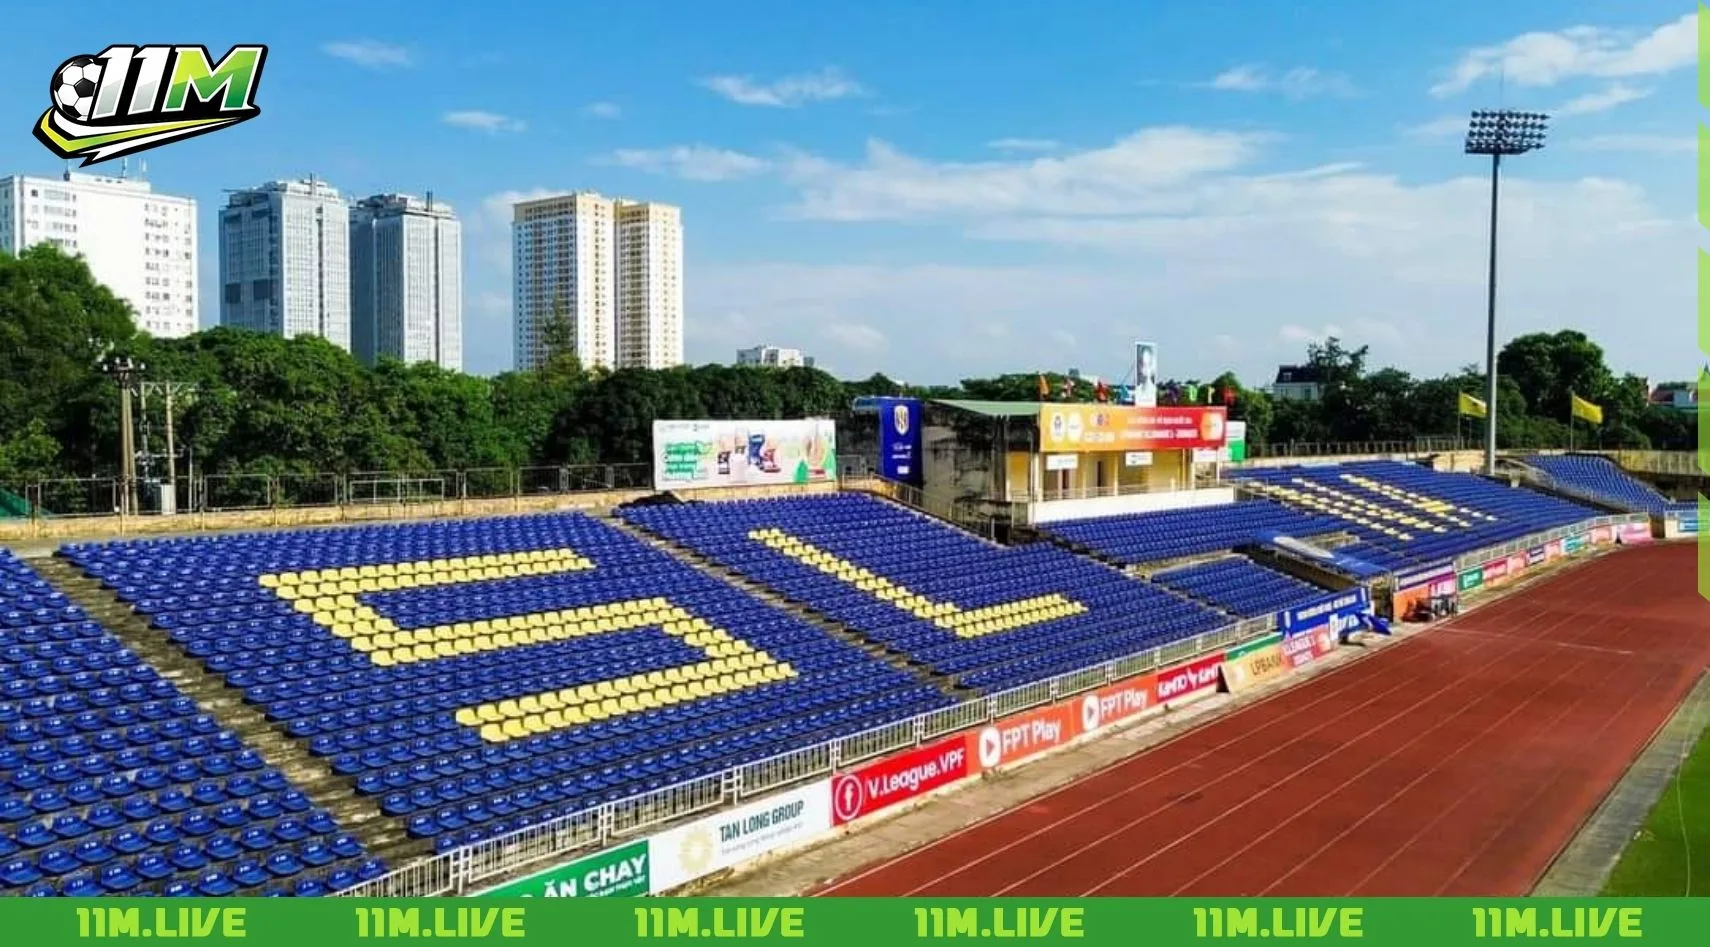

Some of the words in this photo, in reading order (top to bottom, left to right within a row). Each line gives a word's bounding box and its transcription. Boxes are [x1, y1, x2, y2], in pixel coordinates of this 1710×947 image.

[1101, 694, 1123, 719] FPT
[1124, 689, 1149, 712] Play
[1001, 724, 1031, 755] FPT
[1031, 718, 1062, 748] Play
[869, 747, 965, 800] V.League.VPF
[719, 819, 741, 842] TAN
[742, 811, 770, 835] LONG
[771, 799, 805, 825] GROUP
[583, 853, 648, 893] CHAY
